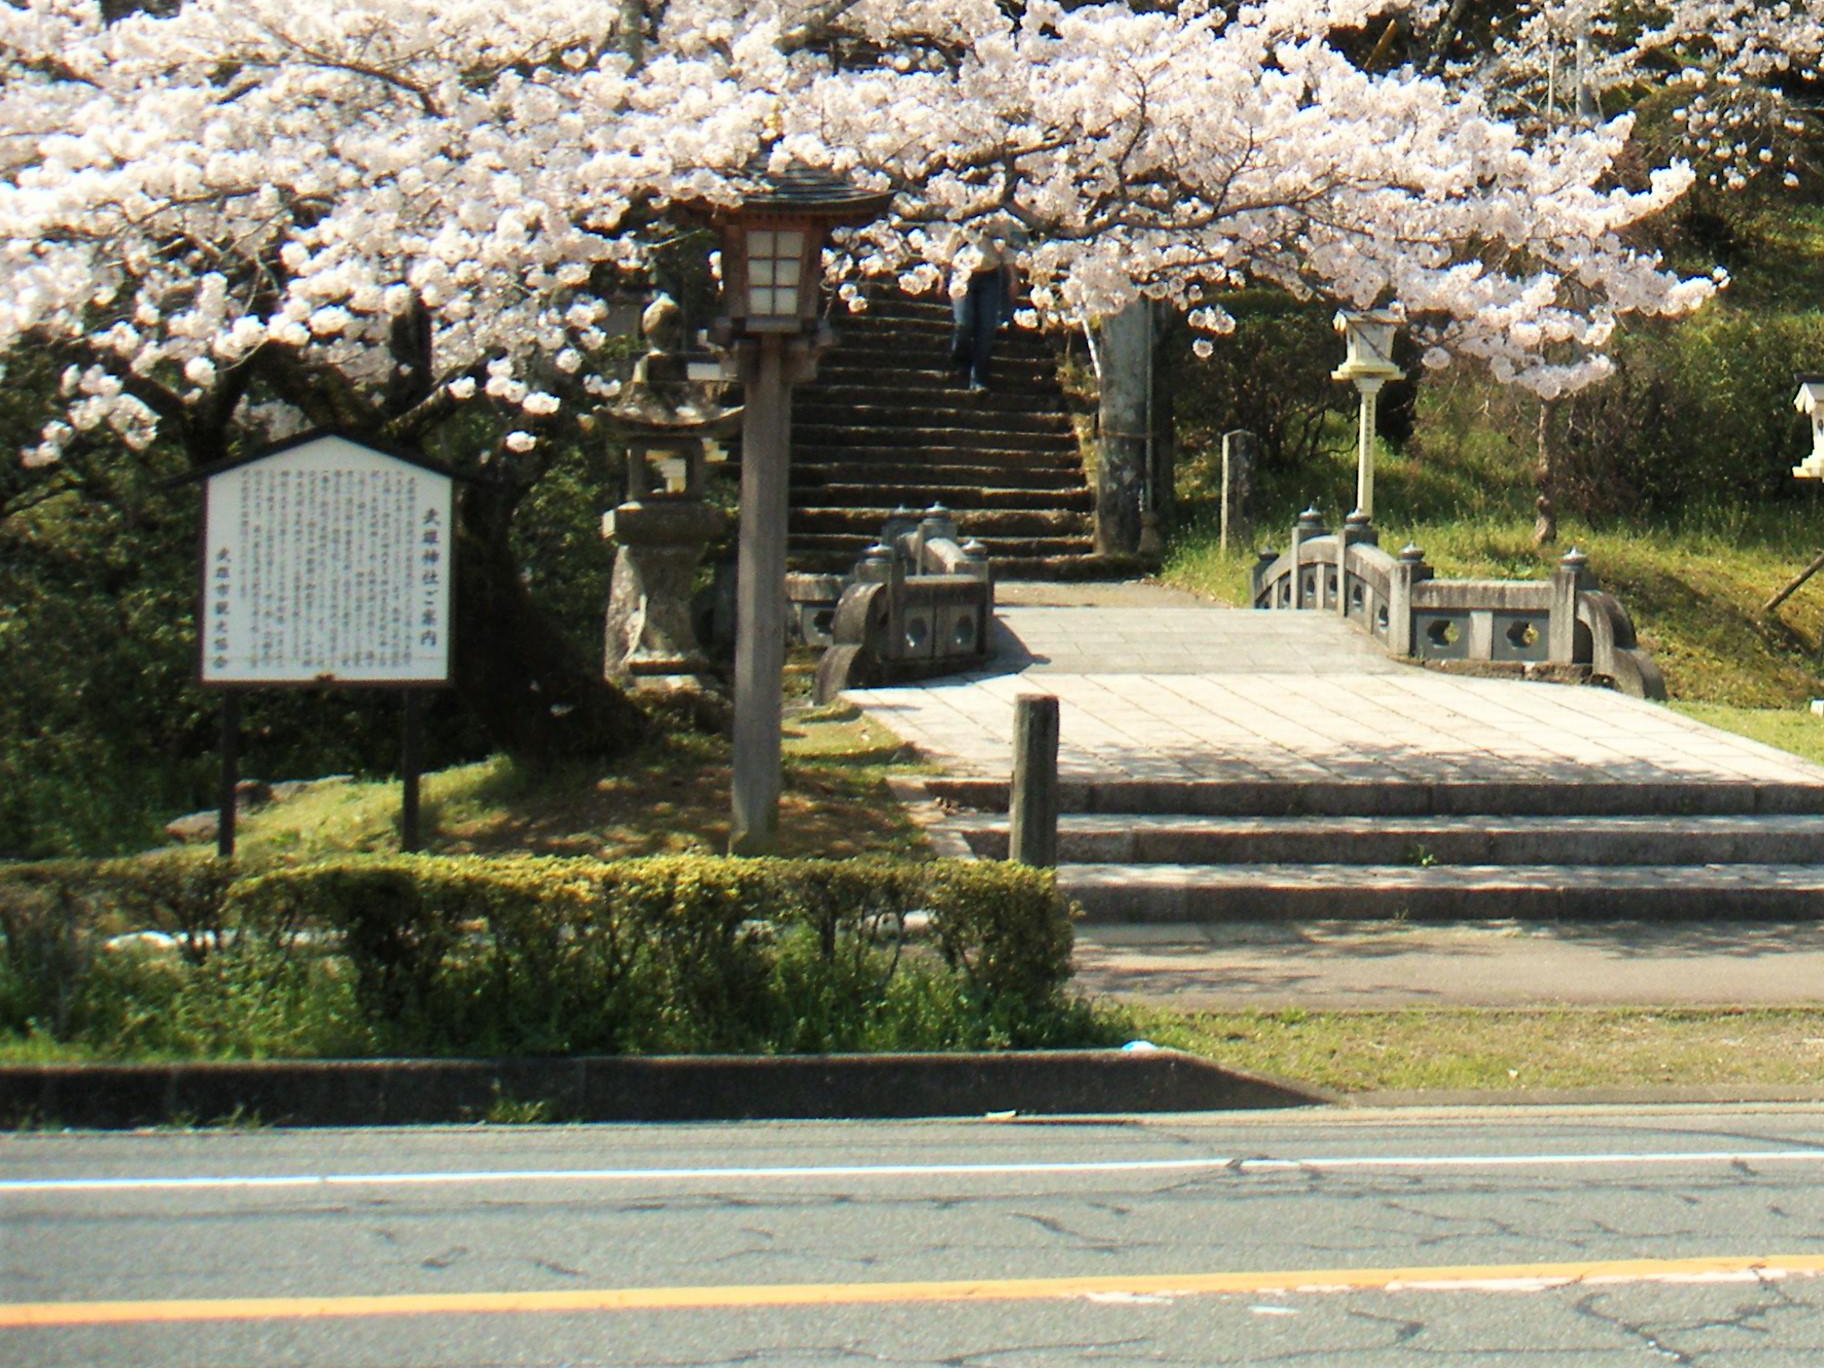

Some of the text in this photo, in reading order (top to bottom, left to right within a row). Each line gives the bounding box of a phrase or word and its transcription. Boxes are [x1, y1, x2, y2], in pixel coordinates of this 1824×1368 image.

[420, 507, 441, 647] 武雄神社ご案内
